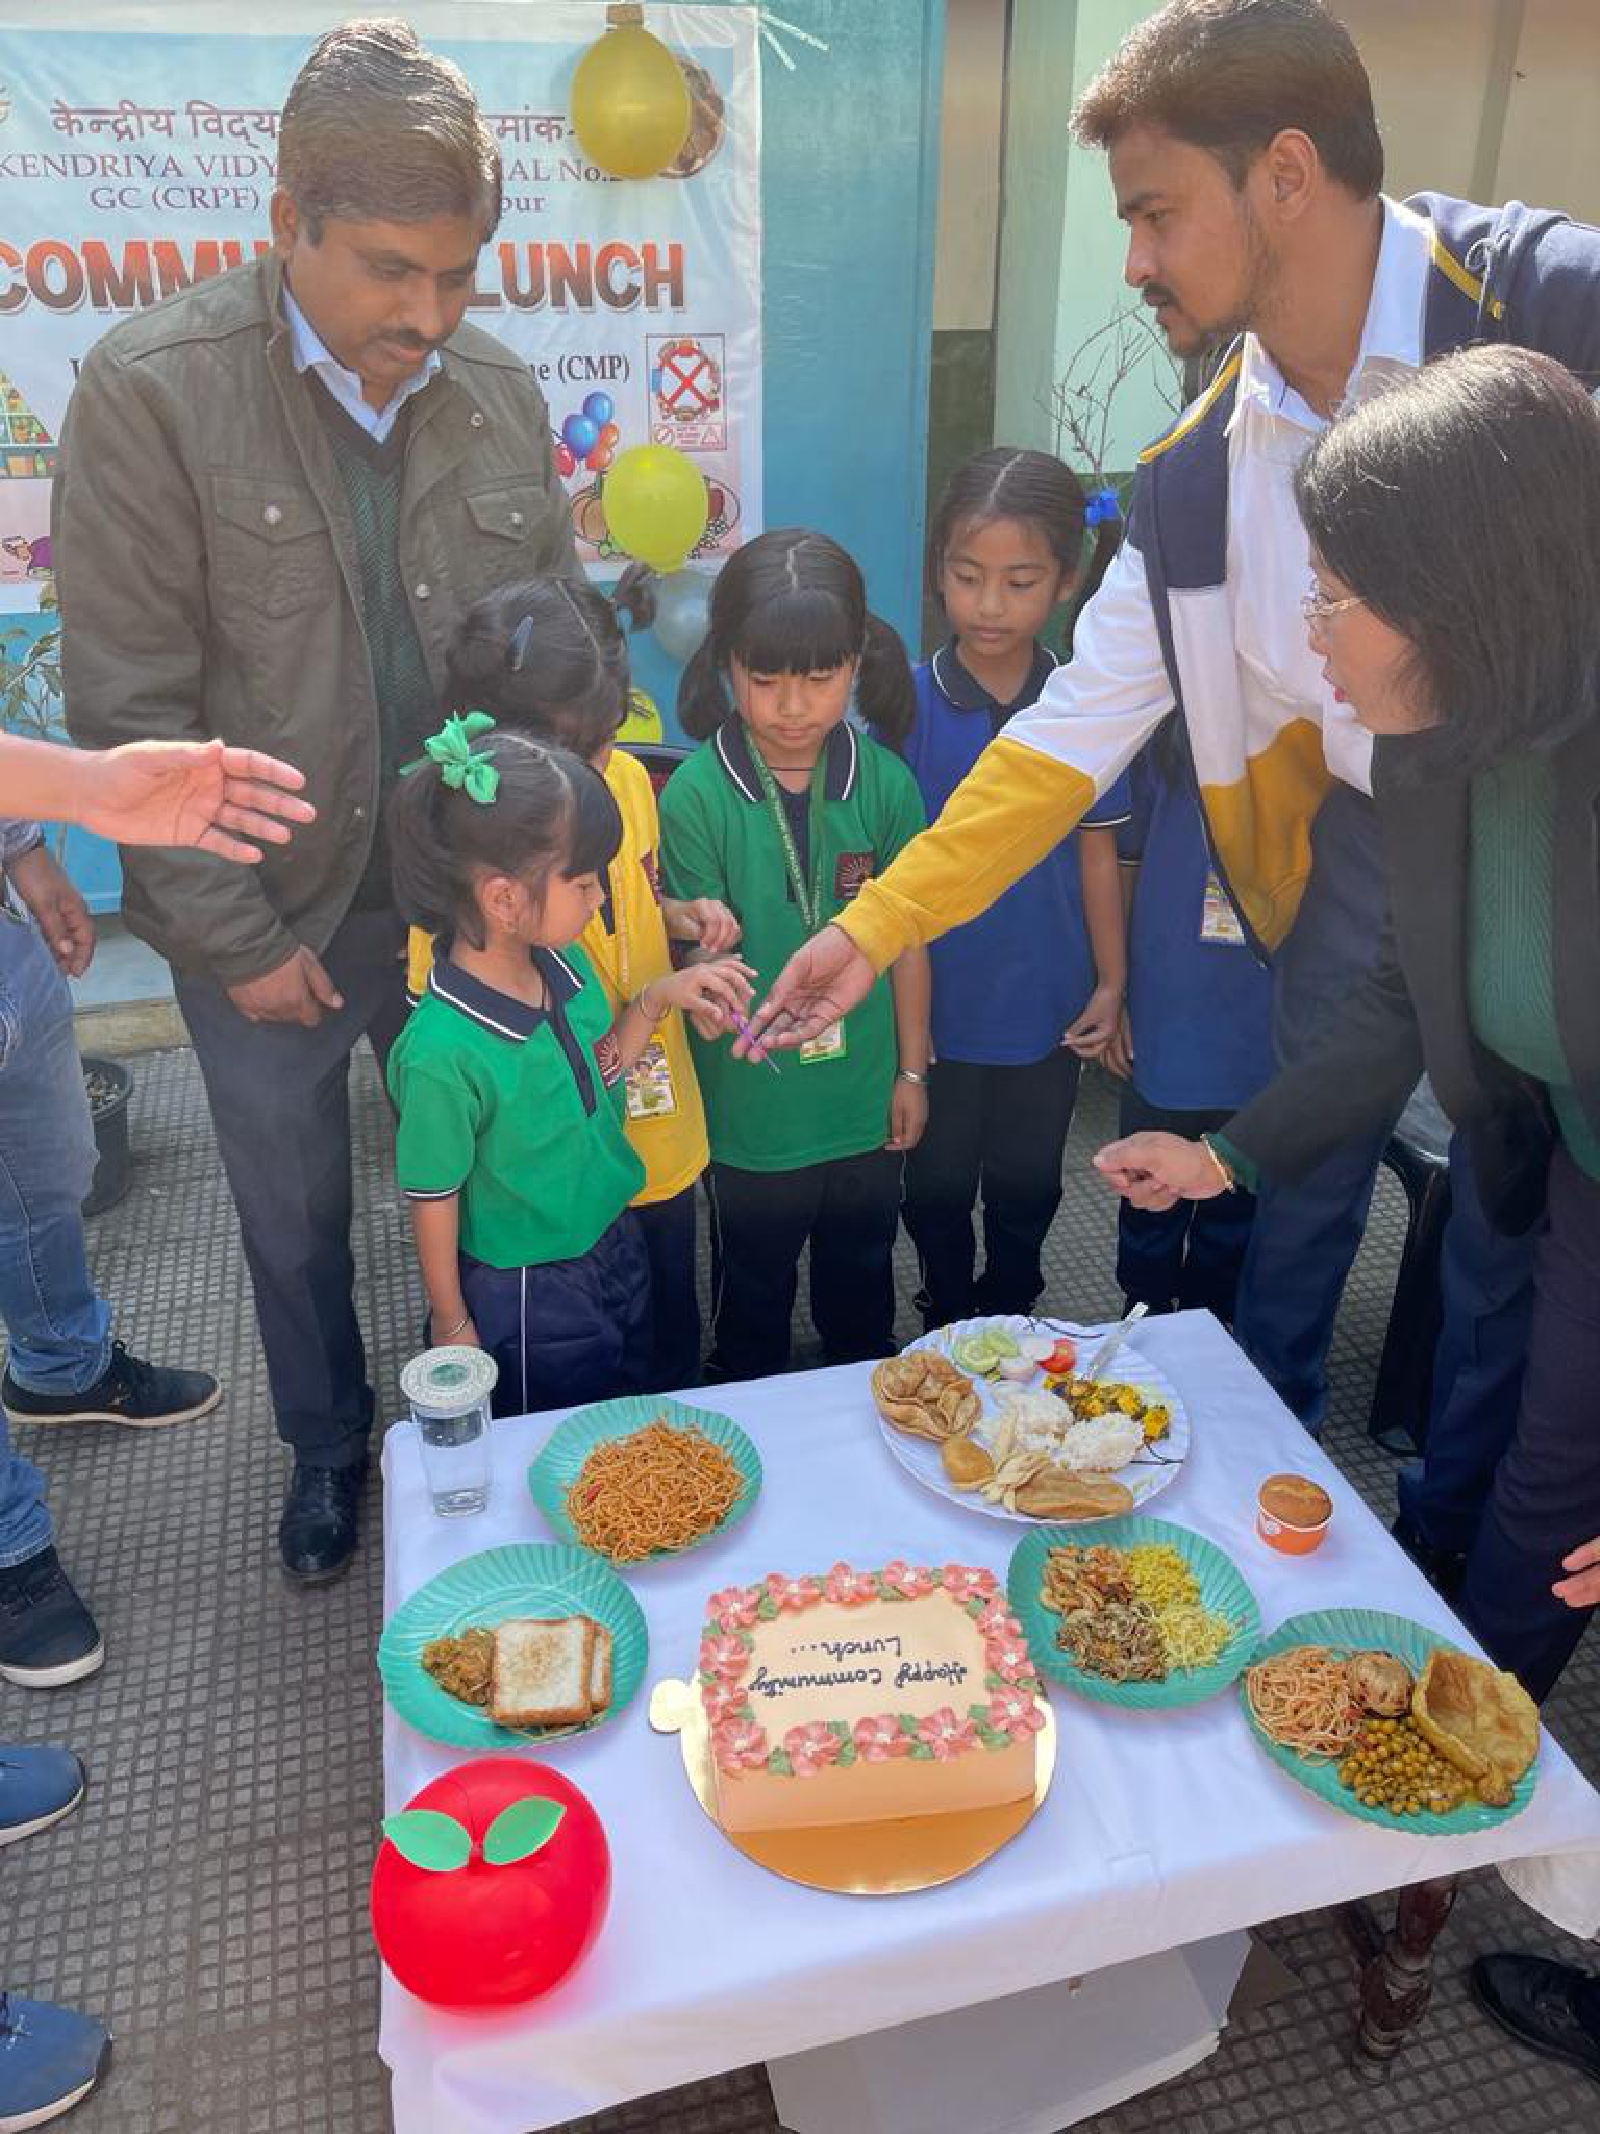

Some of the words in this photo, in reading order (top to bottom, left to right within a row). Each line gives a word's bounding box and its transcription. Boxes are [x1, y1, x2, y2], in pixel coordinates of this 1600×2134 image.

[196, 154, 279, 178] VIDY
[90, 187, 142, 209] GC
[152, 187, 260, 210] (CRPF)
[558, 354, 630, 383] (CMP)
[893, 1661, 967, 1688] Happy
